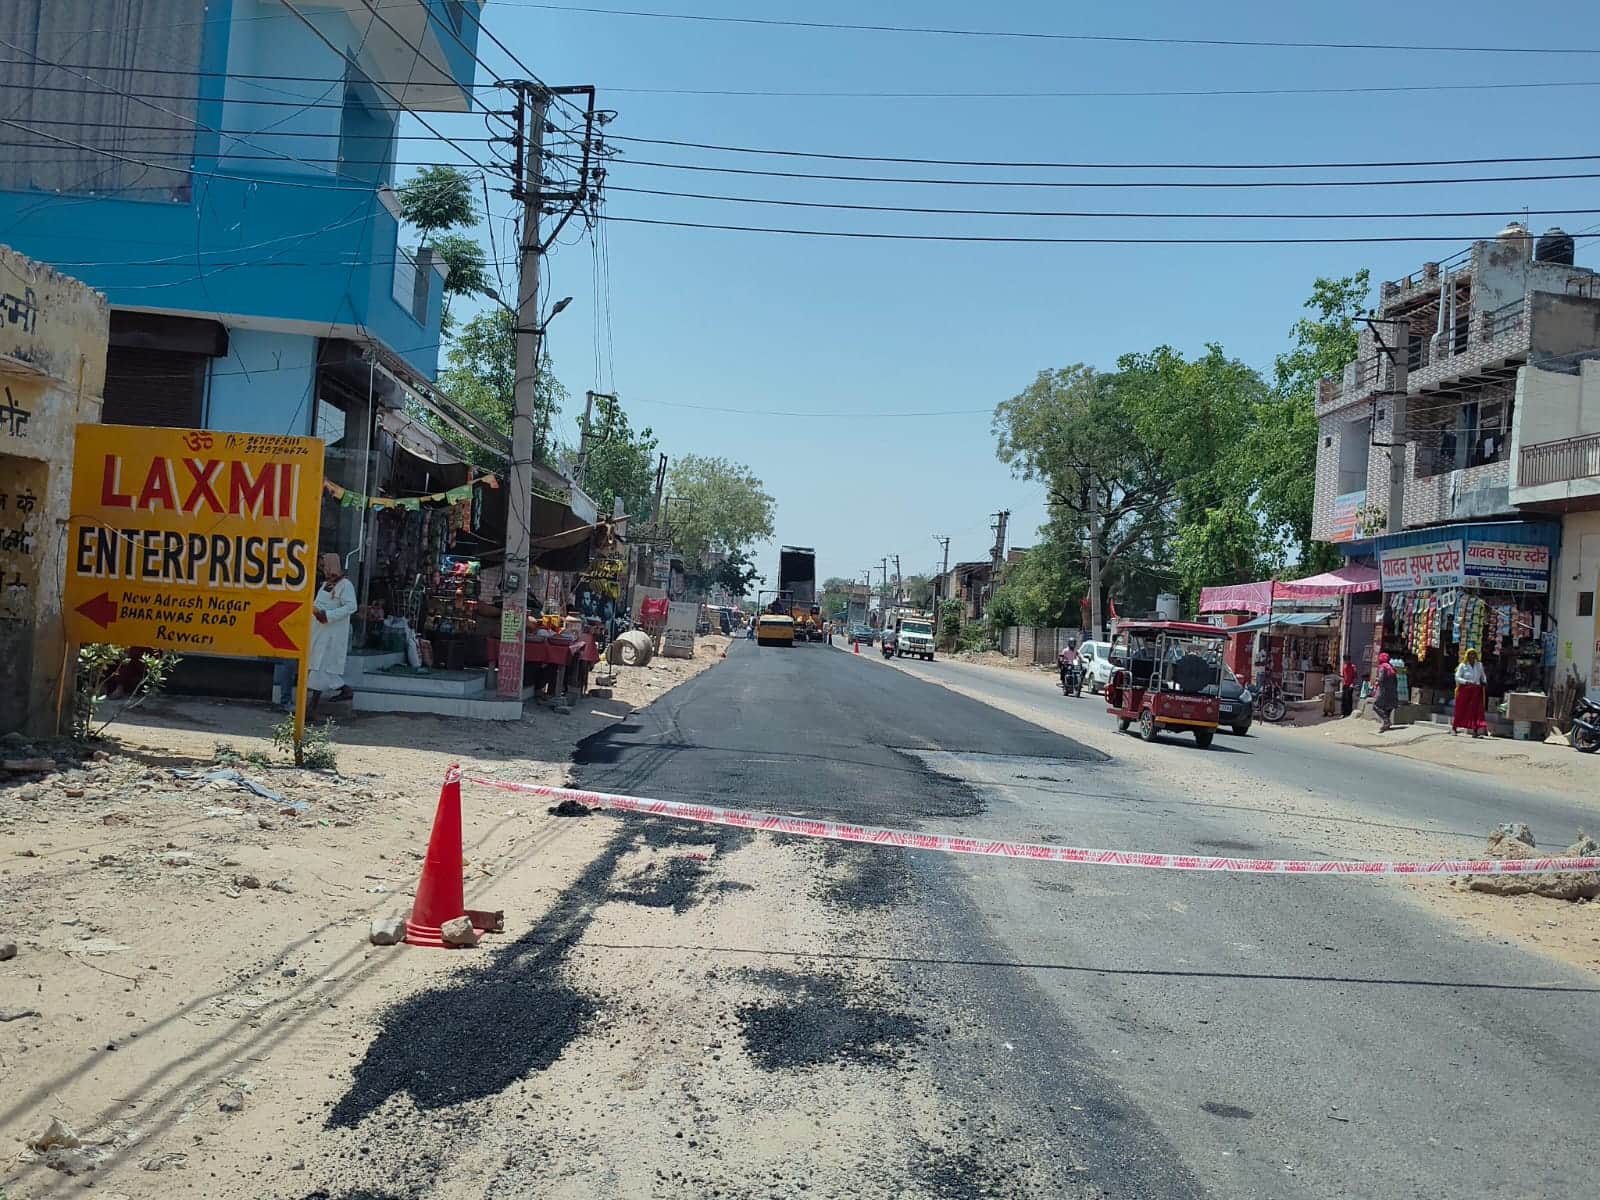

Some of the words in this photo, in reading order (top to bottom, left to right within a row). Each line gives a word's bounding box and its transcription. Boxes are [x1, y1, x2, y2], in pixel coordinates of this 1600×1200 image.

[100, 453, 300, 521] LAXMI
[76, 526, 308, 591] ENTERPRISES
[1382, 558, 1408, 577] यादव
[1409, 554, 1434, 585] सुपर
[1435, 544, 1461, 573] स्टोर
[1467, 546, 1495, 559] यादव
[1497, 548, 1521, 566] सुपर
[1523, 548, 1548, 564] स्टोर
[122, 592, 151, 604] New
[153, 593, 203, 609] Adrash
[208, 597, 251, 614] Nagar
[120, 606, 194, 623] BHARAWAS
[201, 613, 237, 626] ROAD
[156, 625, 214, 644] Rewari
